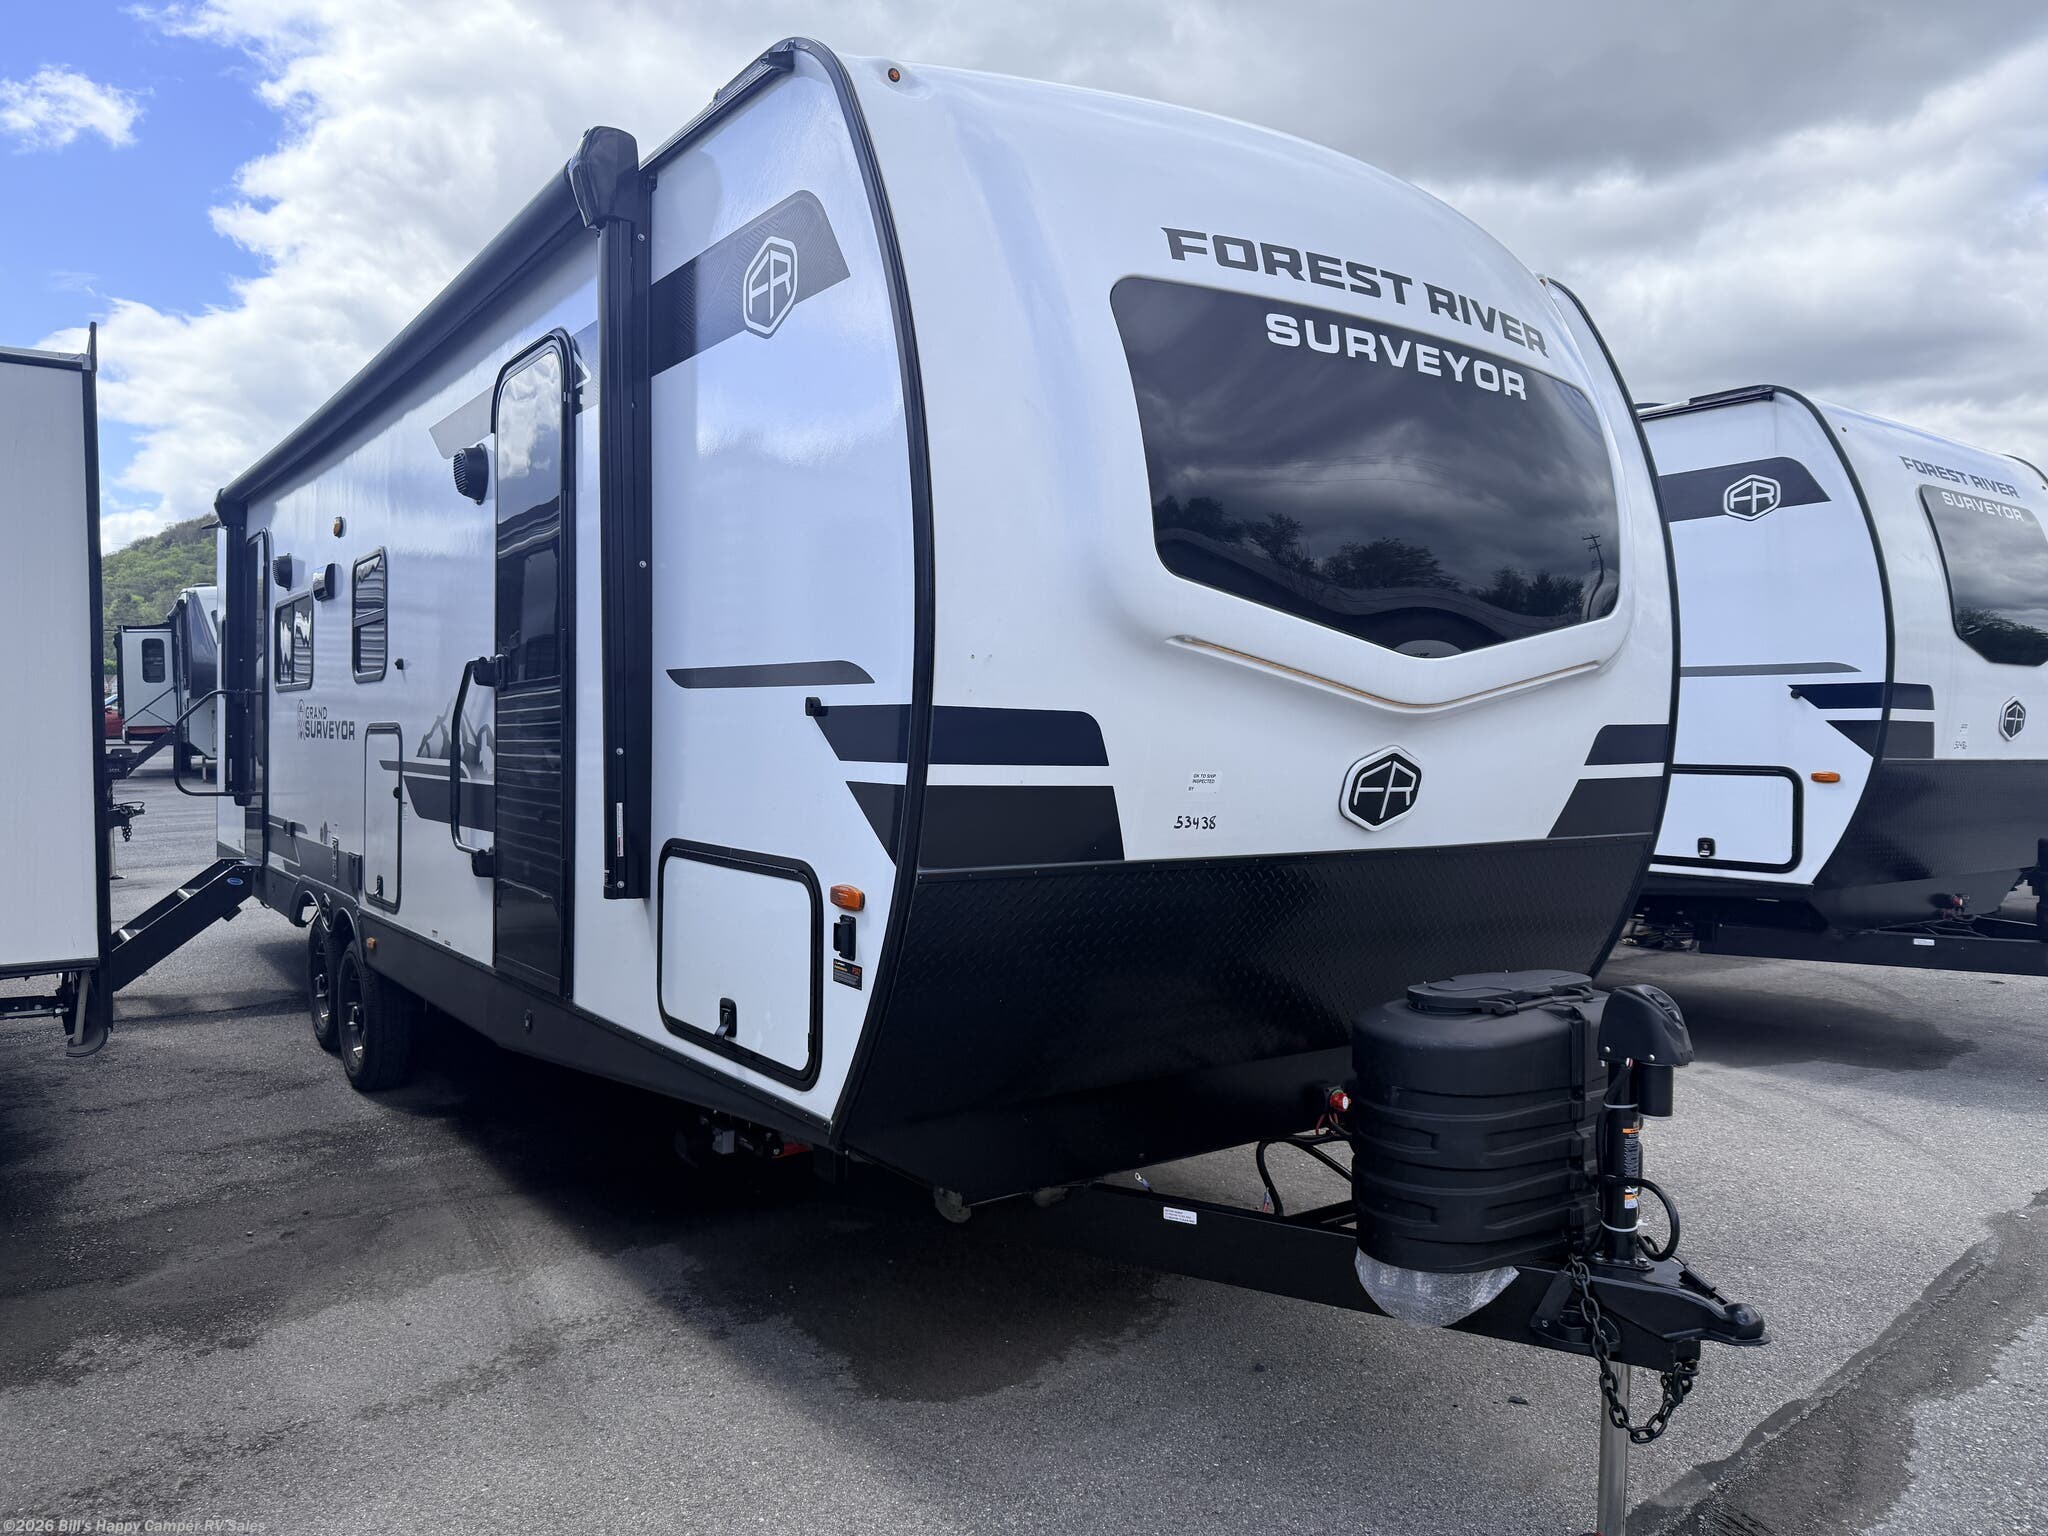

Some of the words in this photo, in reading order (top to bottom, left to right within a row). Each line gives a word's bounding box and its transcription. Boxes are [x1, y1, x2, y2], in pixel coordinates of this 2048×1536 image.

[1161, 227, 1413, 305] FOREST
[1423, 282, 1549, 358] RIVER
[1265, 313, 1526, 401] SURVEYOR
[1899, 456, 1969, 486] FOREST
[1968, 474, 2021, 499] RIVER
[1940, 491, 2025, 522] SURVEYOR
[305, 706, 328, 720] GRAND
[304, 720, 355, 740] SURVEYOR
[1173, 815, 1217, 830] 53438
